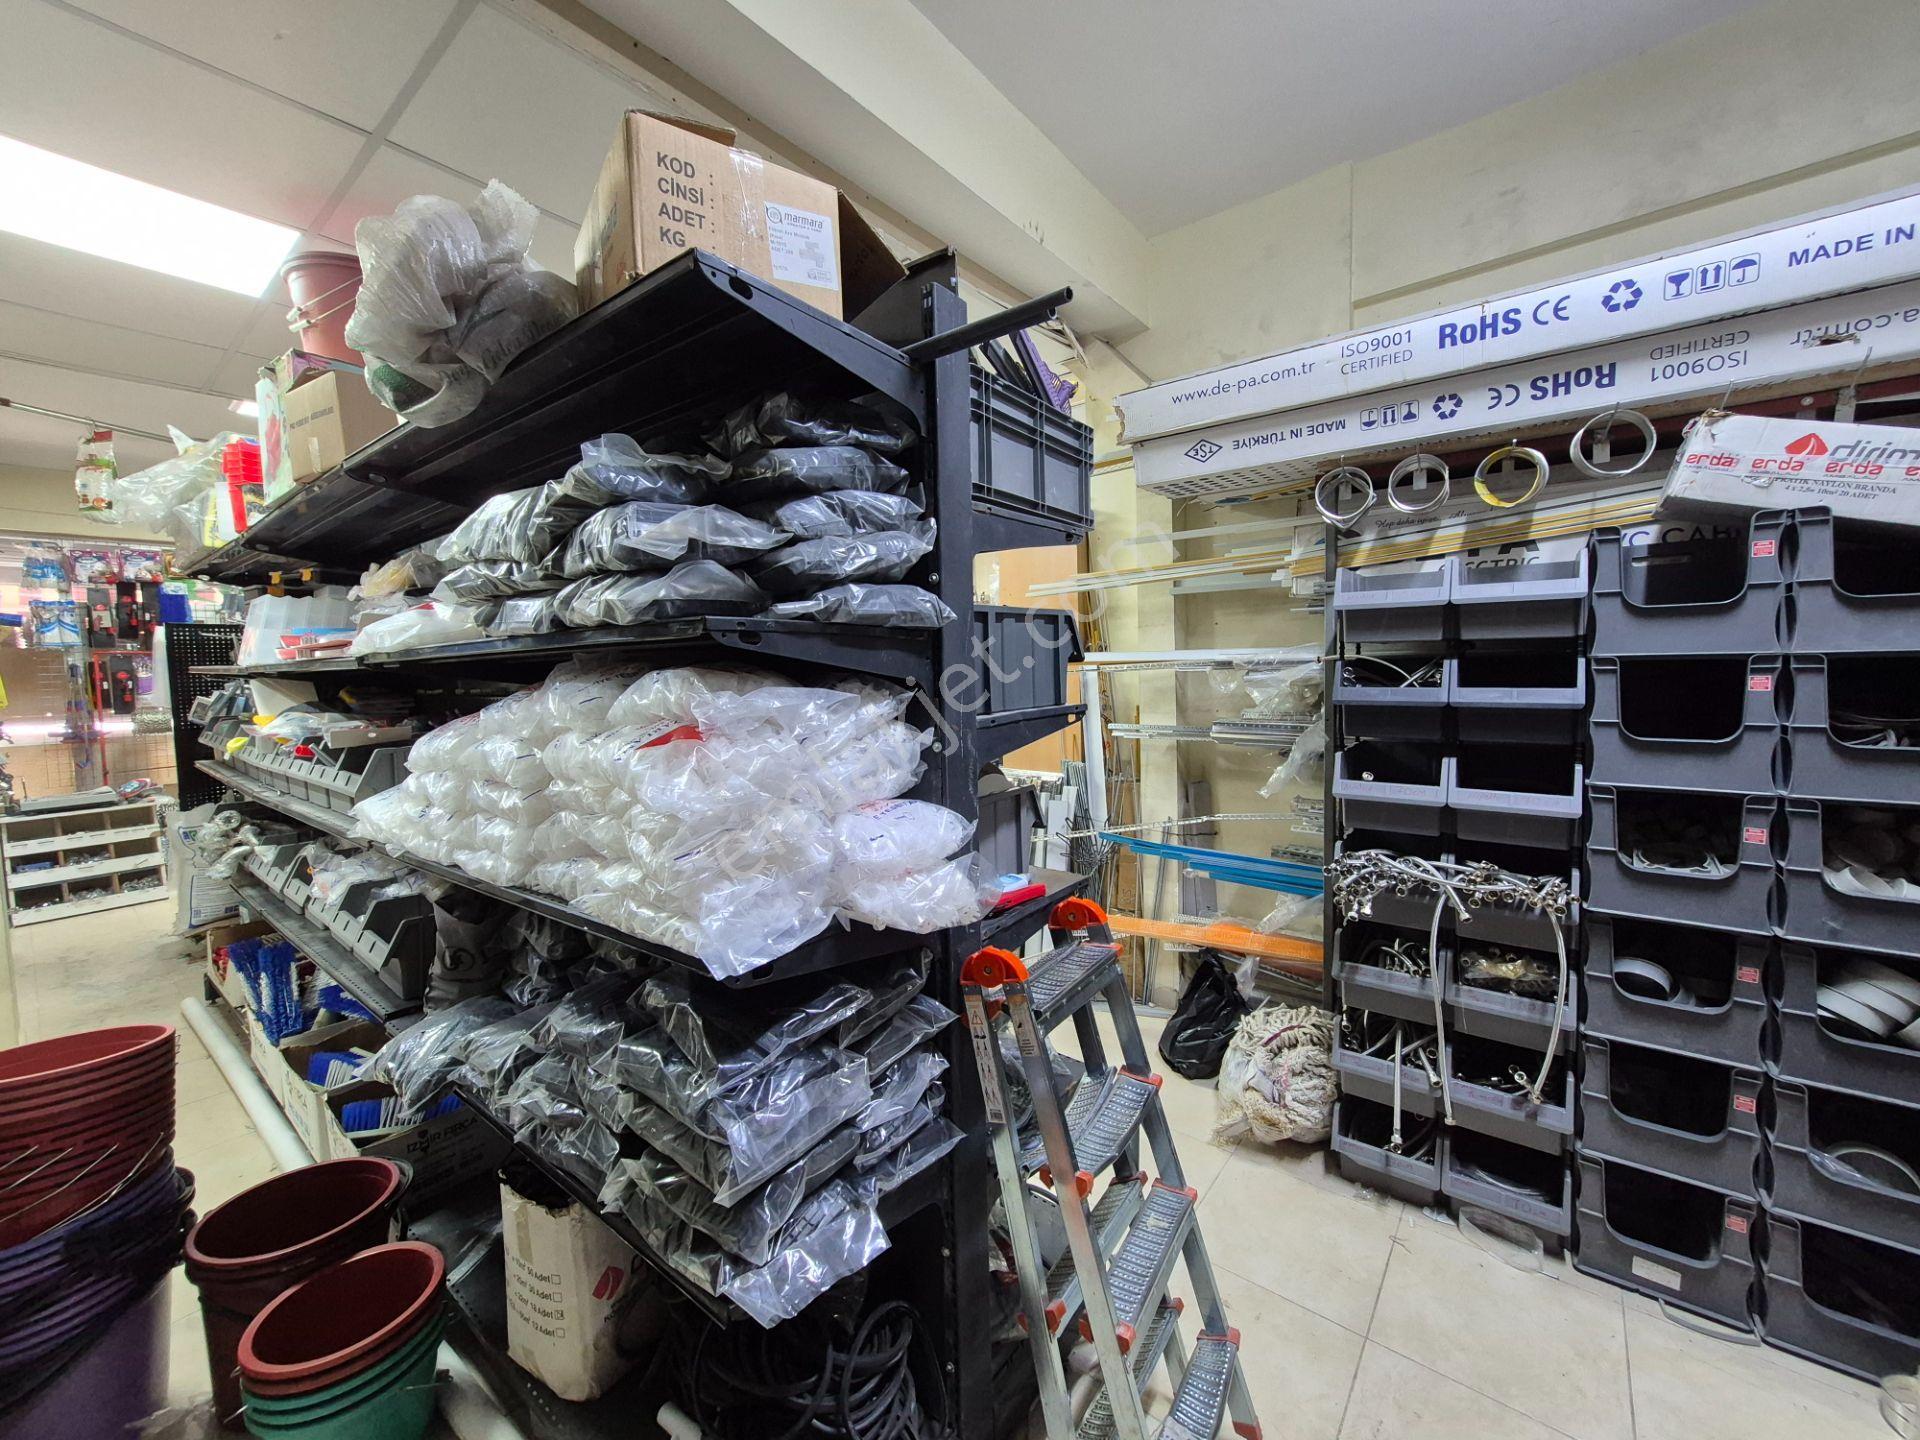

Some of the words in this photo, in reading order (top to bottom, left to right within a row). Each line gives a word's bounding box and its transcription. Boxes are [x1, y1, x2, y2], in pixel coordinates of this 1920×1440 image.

[657, 151, 695, 179] KOD
[658, 202, 706, 229] ADET
[784, 212, 823, 229] marmara
[660, 225, 686, 247] KG
[1788, 233, 1874, 267] MADE
[1885, 223, 1915, 245] IN
[1438, 308, 1522, 349] RoHS
[1341, 330, 1413, 359] ISO9001
[1650, 329, 1750, 361] CERTIFIED
[1340, 349, 1413, 376] CERTIFIED
[1650, 350, 1748, 383] ISO9001
[1171, 359, 1316, 405] www.de-pa.com.tr
[1530, 362, 1617, 401] RoHS
[1232, 430, 1286, 451] TÜRKİYE
[1290, 427, 1303, 440] IN
[1307, 418, 1346, 437] MADE
[1686, 452, 1734, 468] erda
[1751, 456, 1804, 471] erda
[1825, 459, 1884, 475] erda
[1850, 491, 1879, 500] ADET
[1854, 482, 1896, 494] BRANDA
